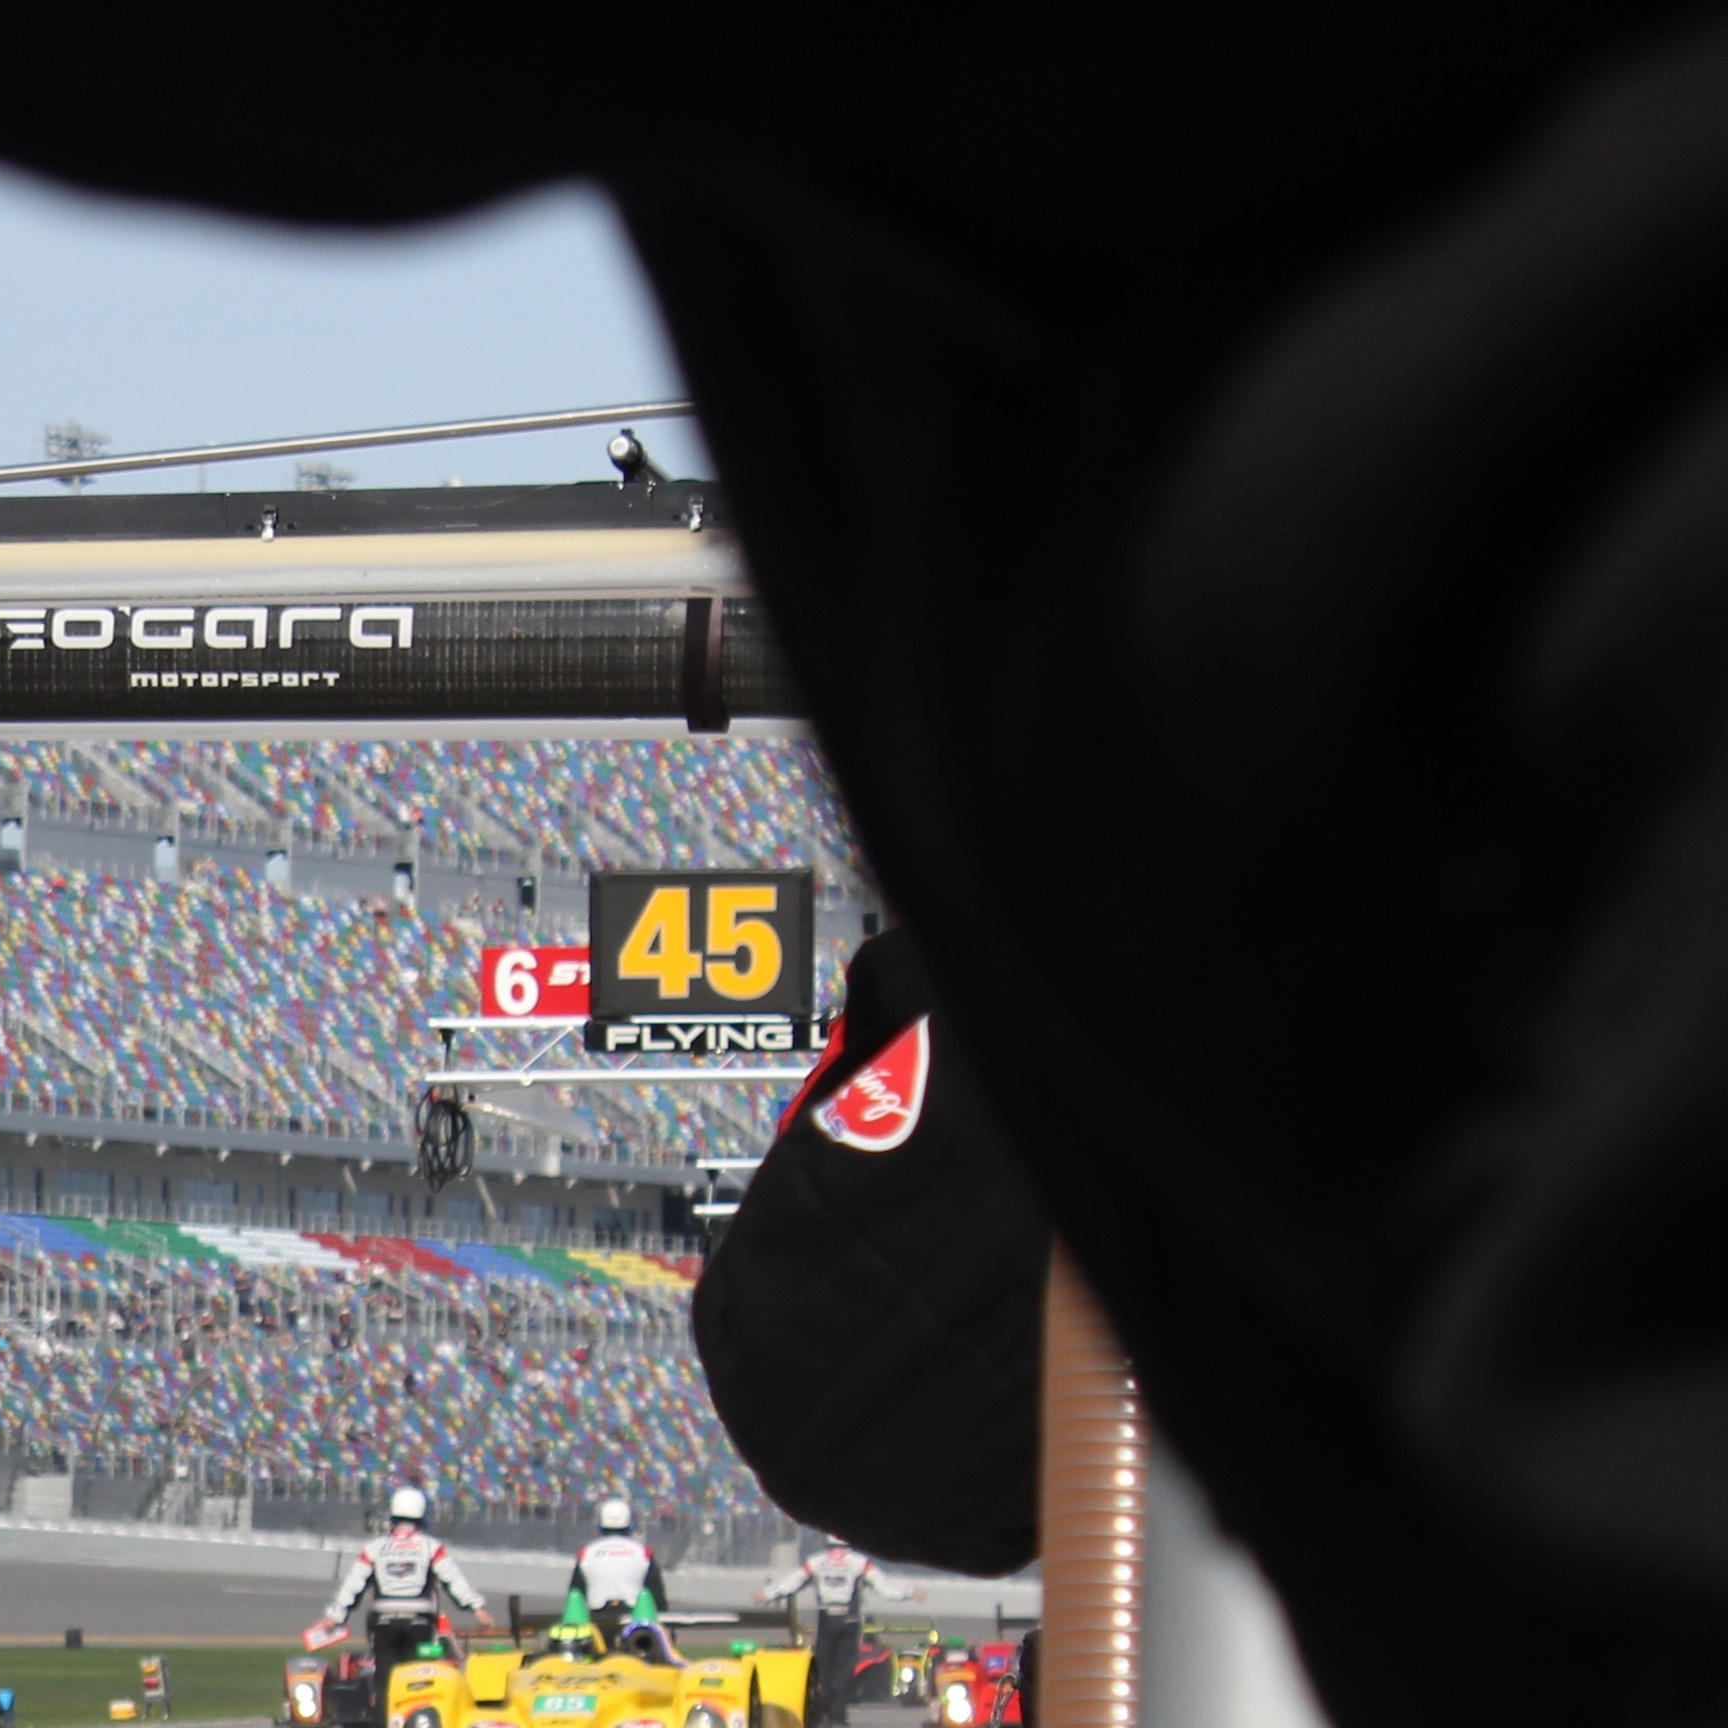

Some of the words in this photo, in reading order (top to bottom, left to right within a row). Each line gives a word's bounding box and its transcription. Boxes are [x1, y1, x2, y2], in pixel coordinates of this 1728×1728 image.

[617, 886, 783, 1001] 45
[493, 950, 540, 1017] 6
[605, 1026, 794, 1051] FLYING
